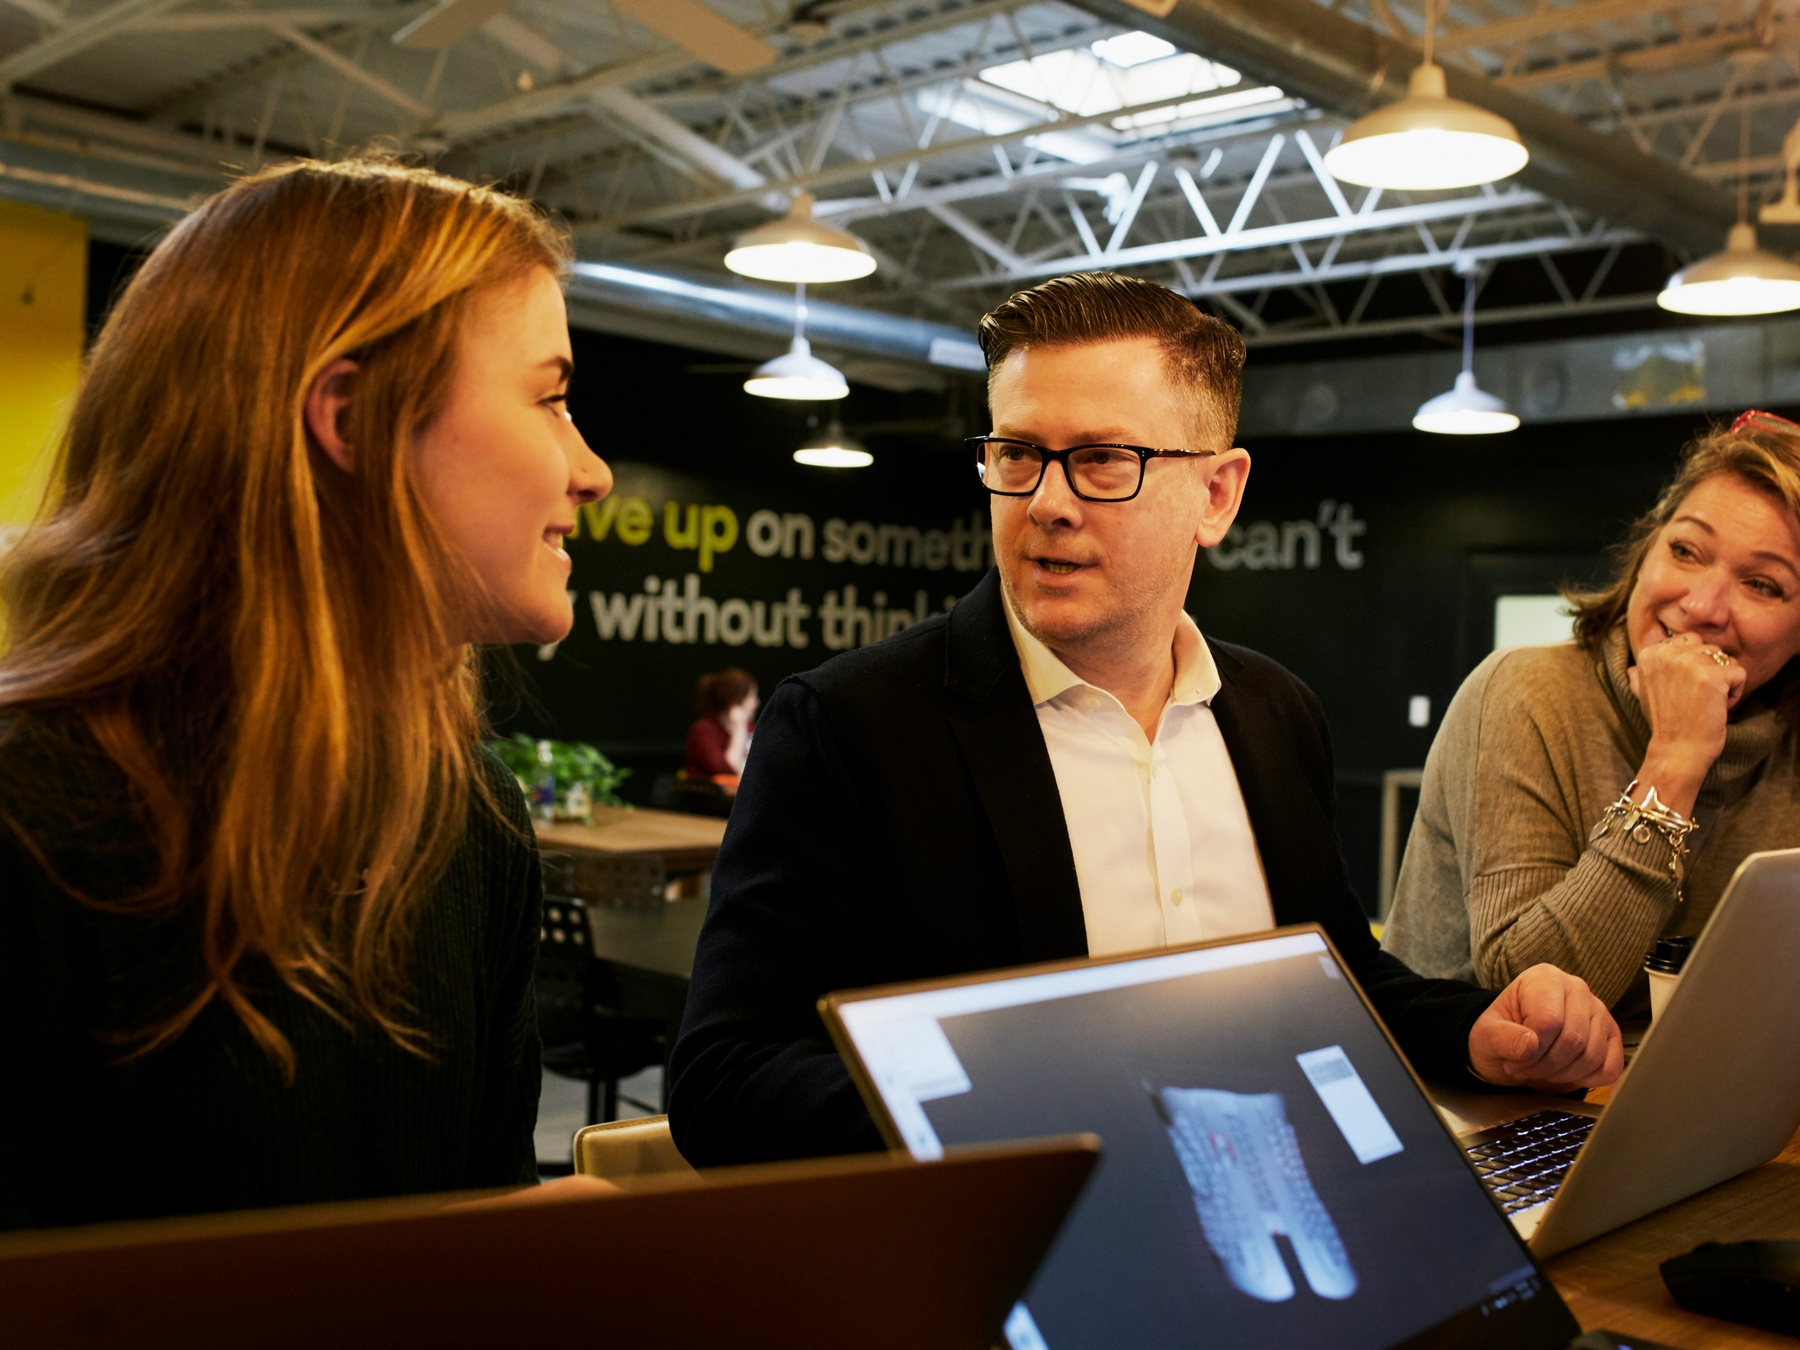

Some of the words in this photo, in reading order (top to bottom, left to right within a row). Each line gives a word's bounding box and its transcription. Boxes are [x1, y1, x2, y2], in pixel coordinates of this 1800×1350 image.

[663, 500, 739, 572] up
[746, 510, 815, 559] on
[822, 508, 998, 572] someth
[1207, 499, 1367, 571] can't
[589, 573, 811, 649] without
